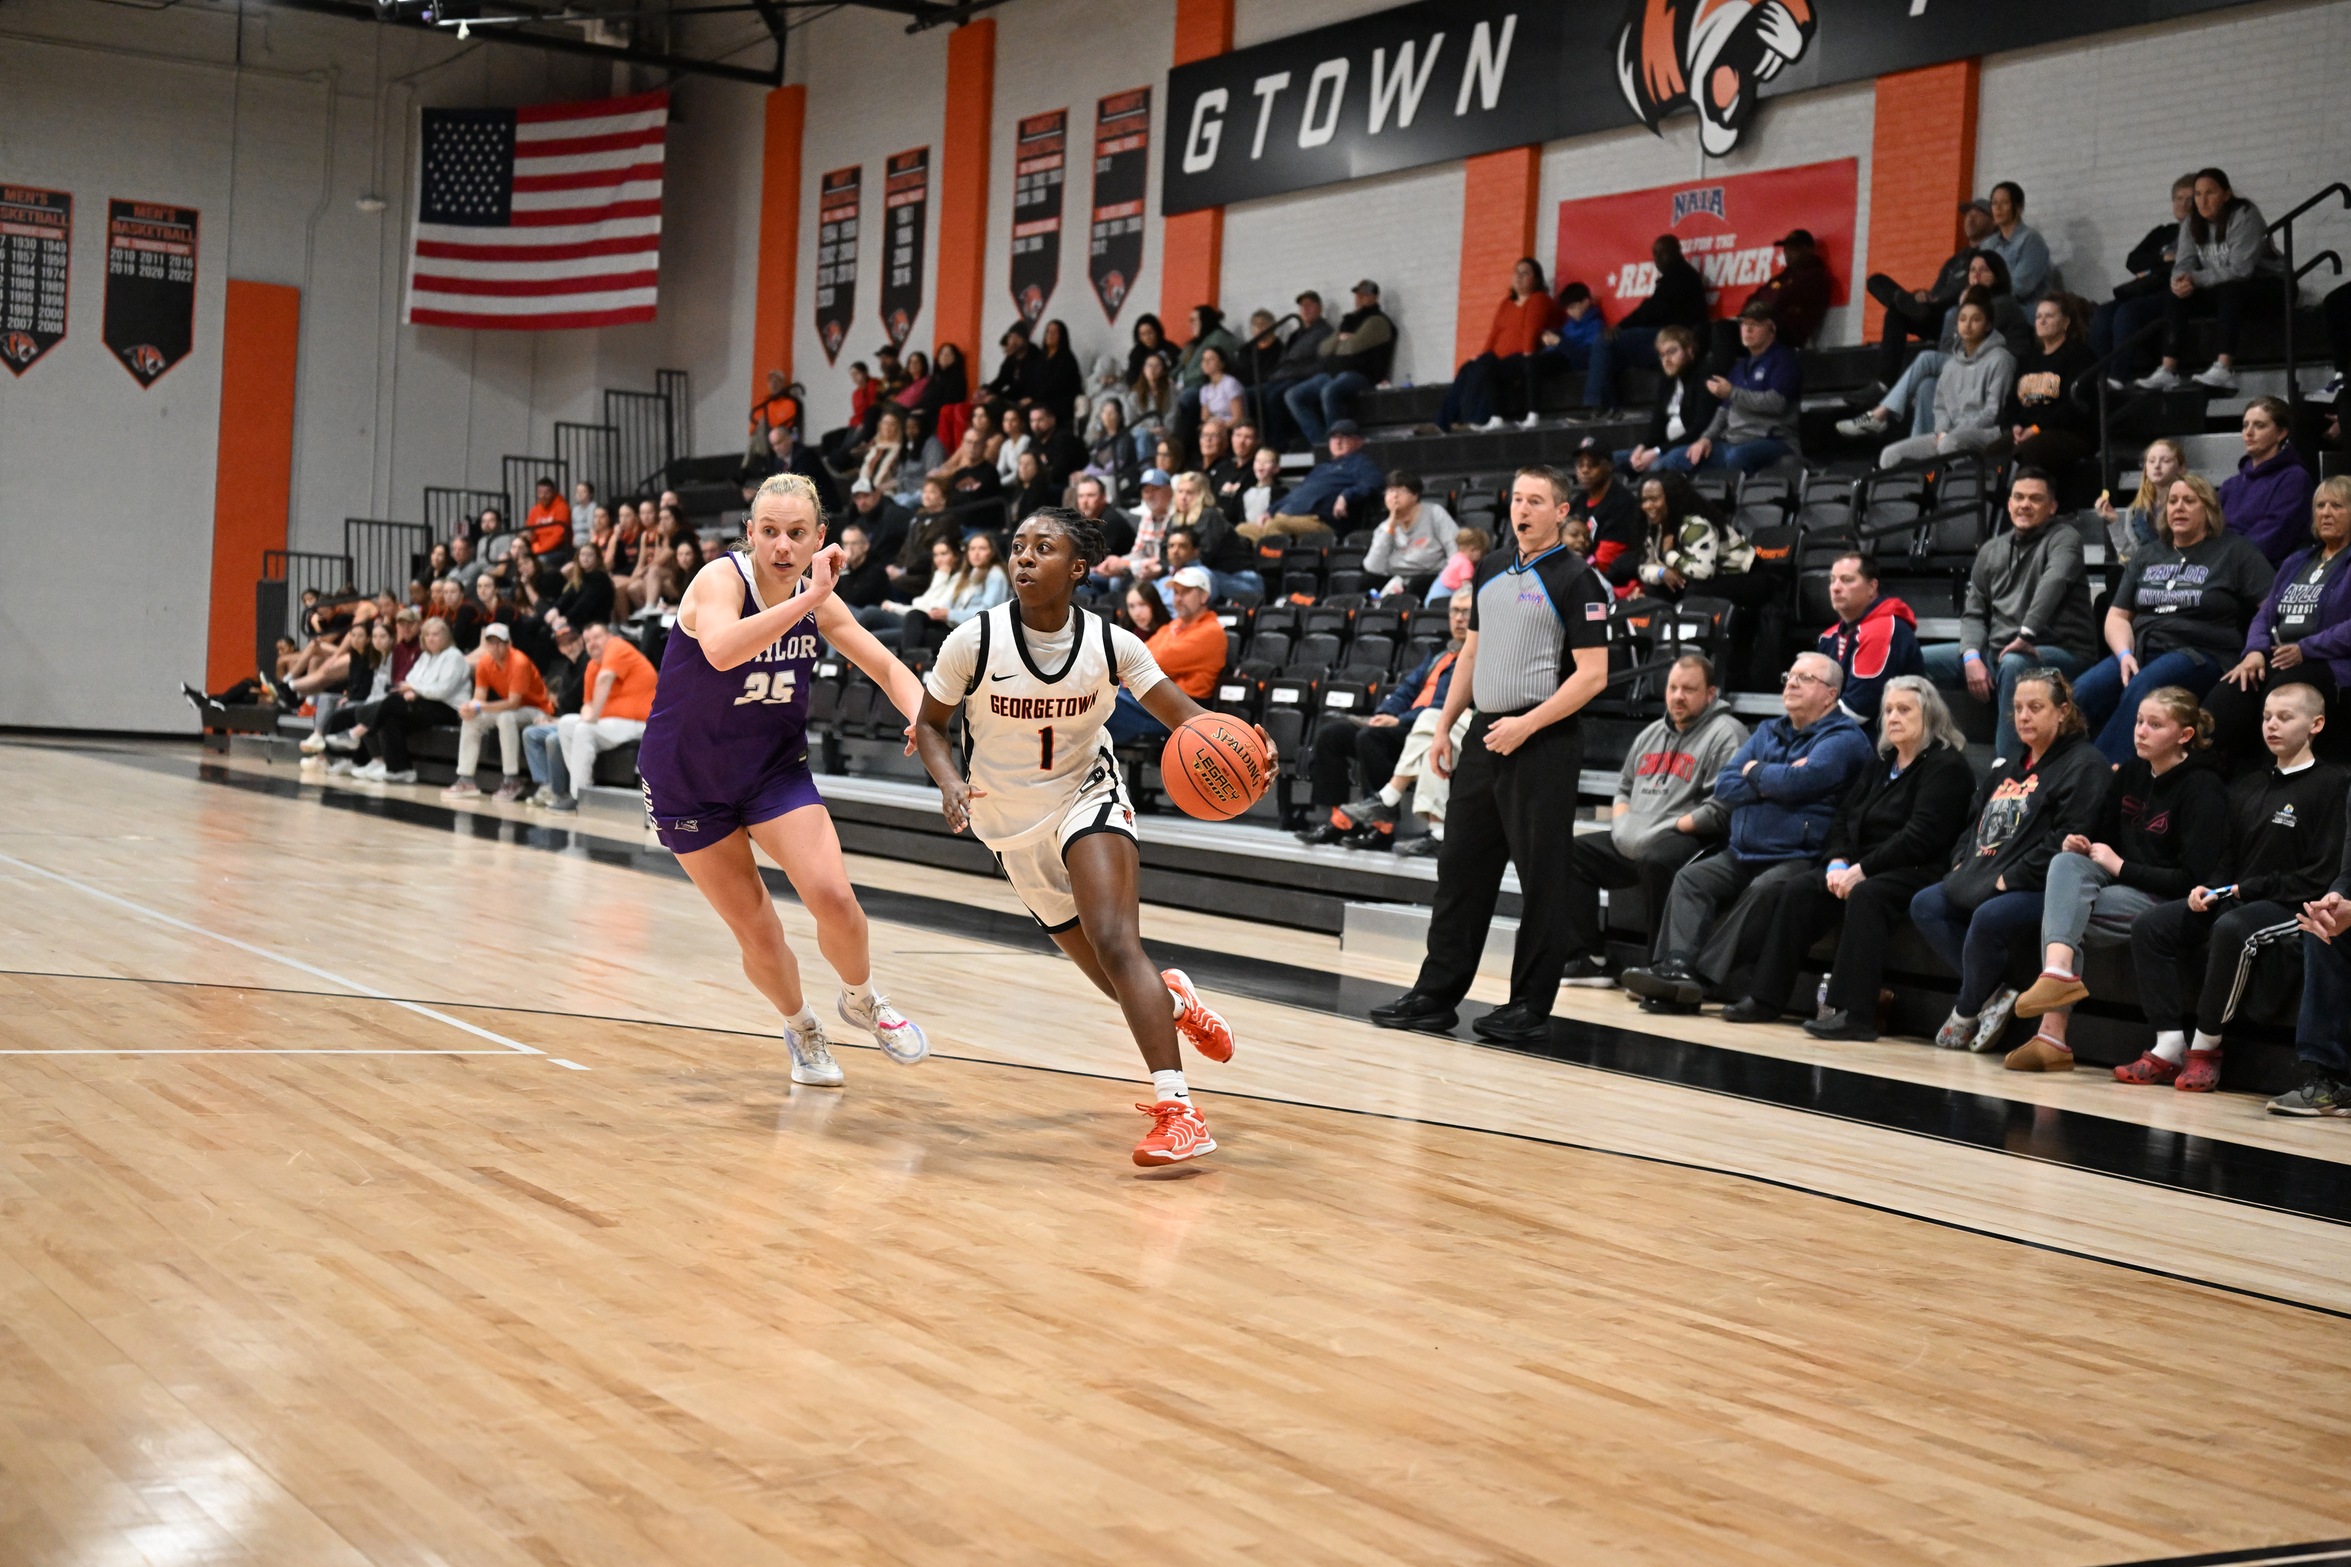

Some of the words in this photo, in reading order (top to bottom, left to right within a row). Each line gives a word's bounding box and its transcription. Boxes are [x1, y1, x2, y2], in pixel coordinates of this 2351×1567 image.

[1183, 14, 1517, 174] GTOWN
[1671, 186, 1725, 227] NAIA
[139, 251, 164, 265] 2011
[139, 265, 164, 279] 2020
[7, 317, 33, 330] 2007
[2143, 564, 2209, 584] TAYLOR
[1518, 591, 1544, 607] NAIA
[733, 669, 797, 707] 25
[990, 689, 1100, 720] GEORGETOWN
[1037, 725, 1055, 772] 1
[1211, 727, 1264, 789] SPALDING
[1195, 747, 1241, 800] LEGACY
[1201, 772, 1227, 803] 1000
